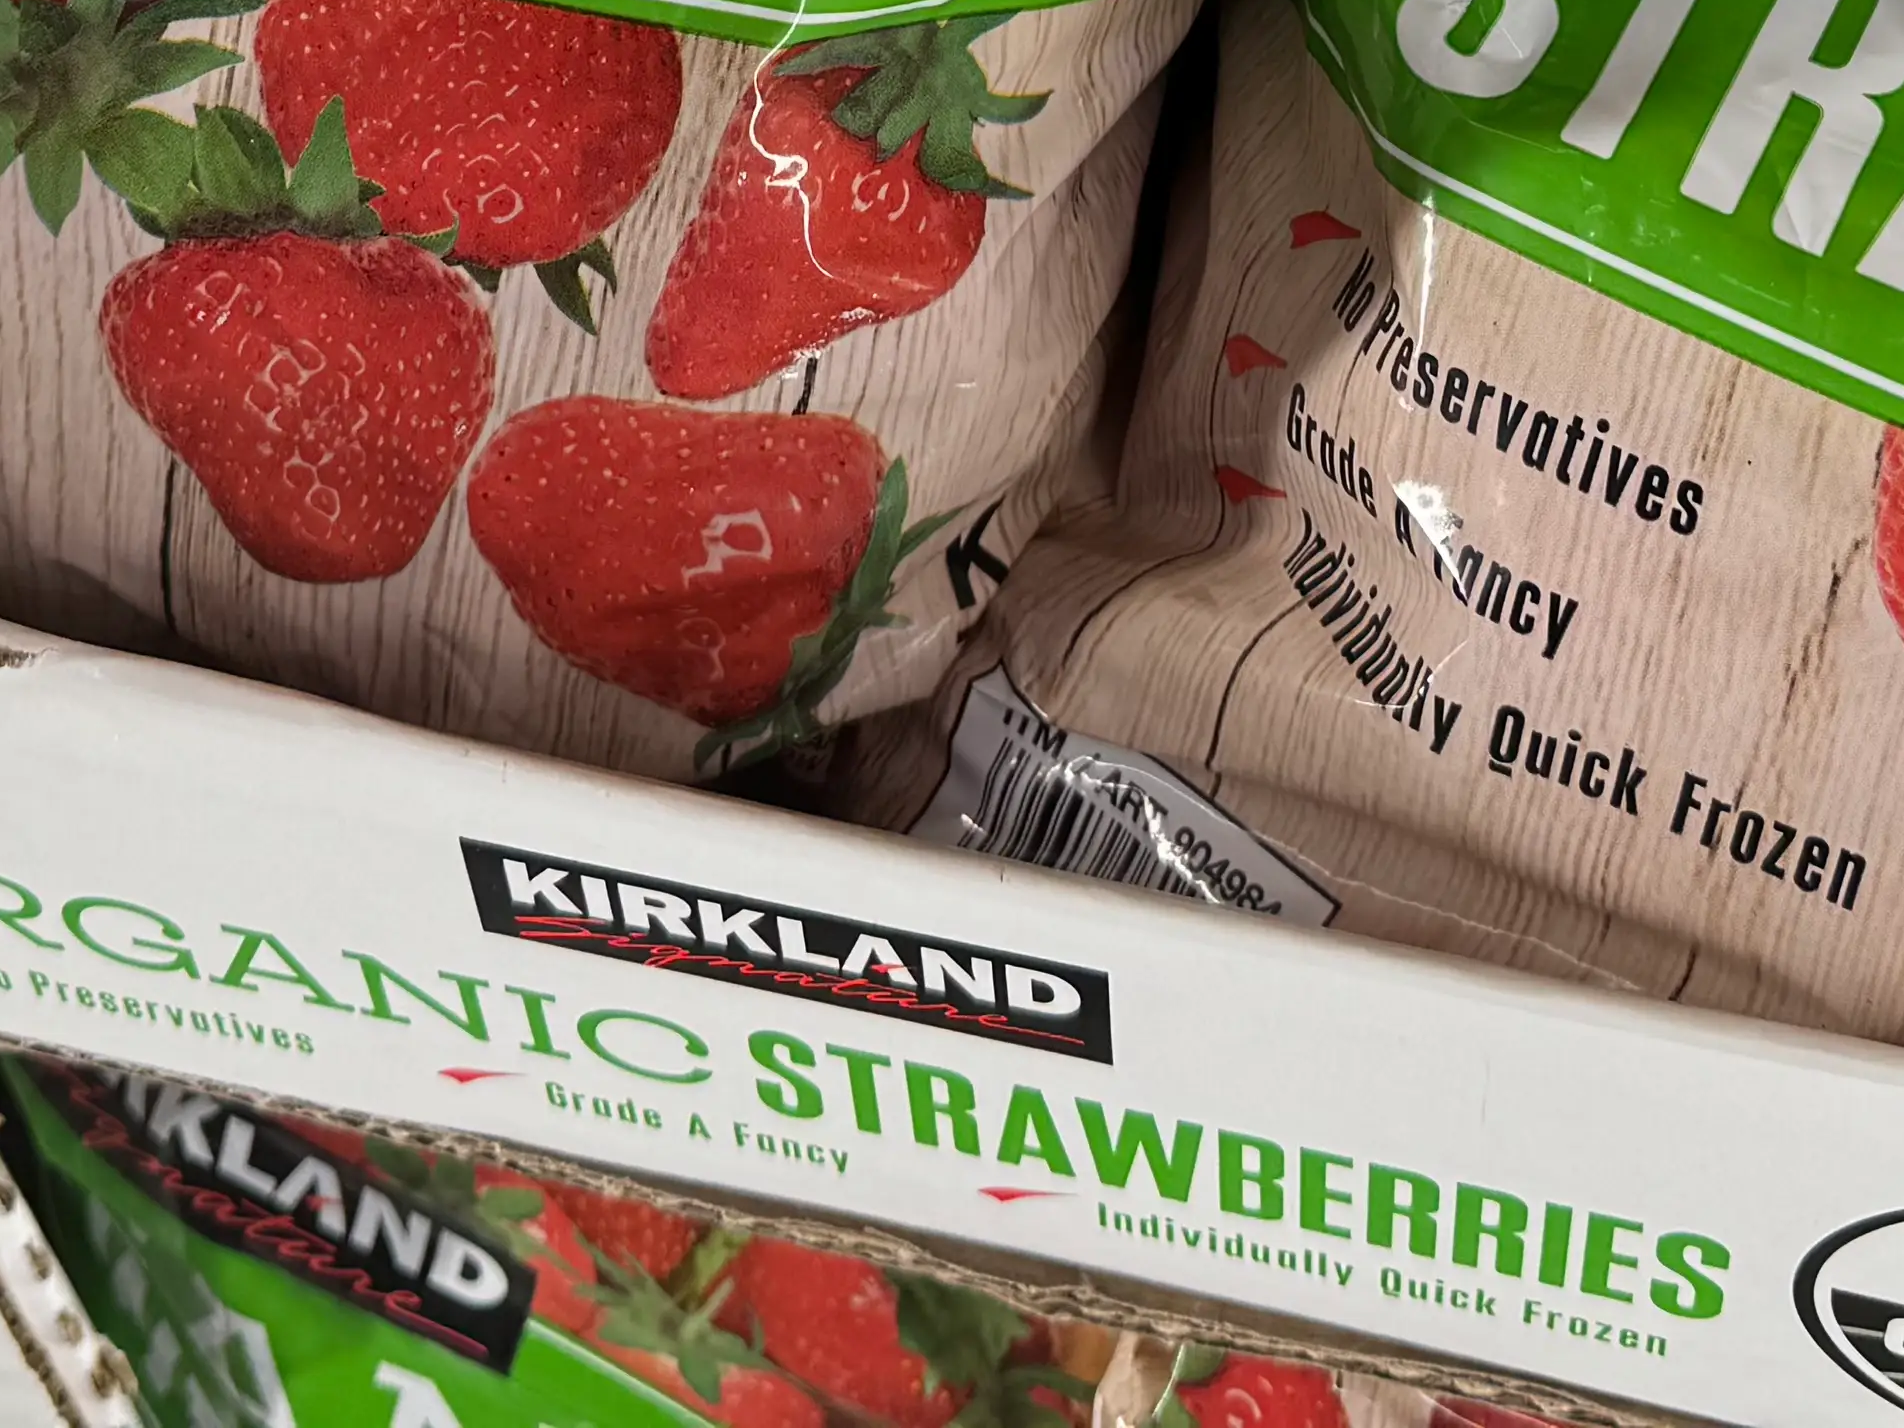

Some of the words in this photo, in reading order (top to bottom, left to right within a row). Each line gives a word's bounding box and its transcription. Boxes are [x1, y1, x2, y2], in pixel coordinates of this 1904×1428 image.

[1286, 382, 1378, 520] Grade
[1331, 247, 1375, 333] No
[1362, 289, 1705, 538] Preservatives
[1283, 509, 1464, 756] Individually
[1487, 702, 1648, 819] Quick
[1669, 770, 1868, 913] Frozen
[27, 968, 317, 1056] Preservatives
[501, 856, 1084, 1019] KIRKLAND
[512, 913, 1088, 1047] Signature
[543, 1080, 663, 1132] Grade
[687, 1110, 714, 1142] A
[732, 1119, 851, 1178] Fancy
[750, 1028, 1734, 1322] STRAWBERRIES
[1096, 1201, 1357, 1293] Individually
[1377, 1265, 1498, 1320] Quick
[1519, 1294, 1671, 1359] Frozen
